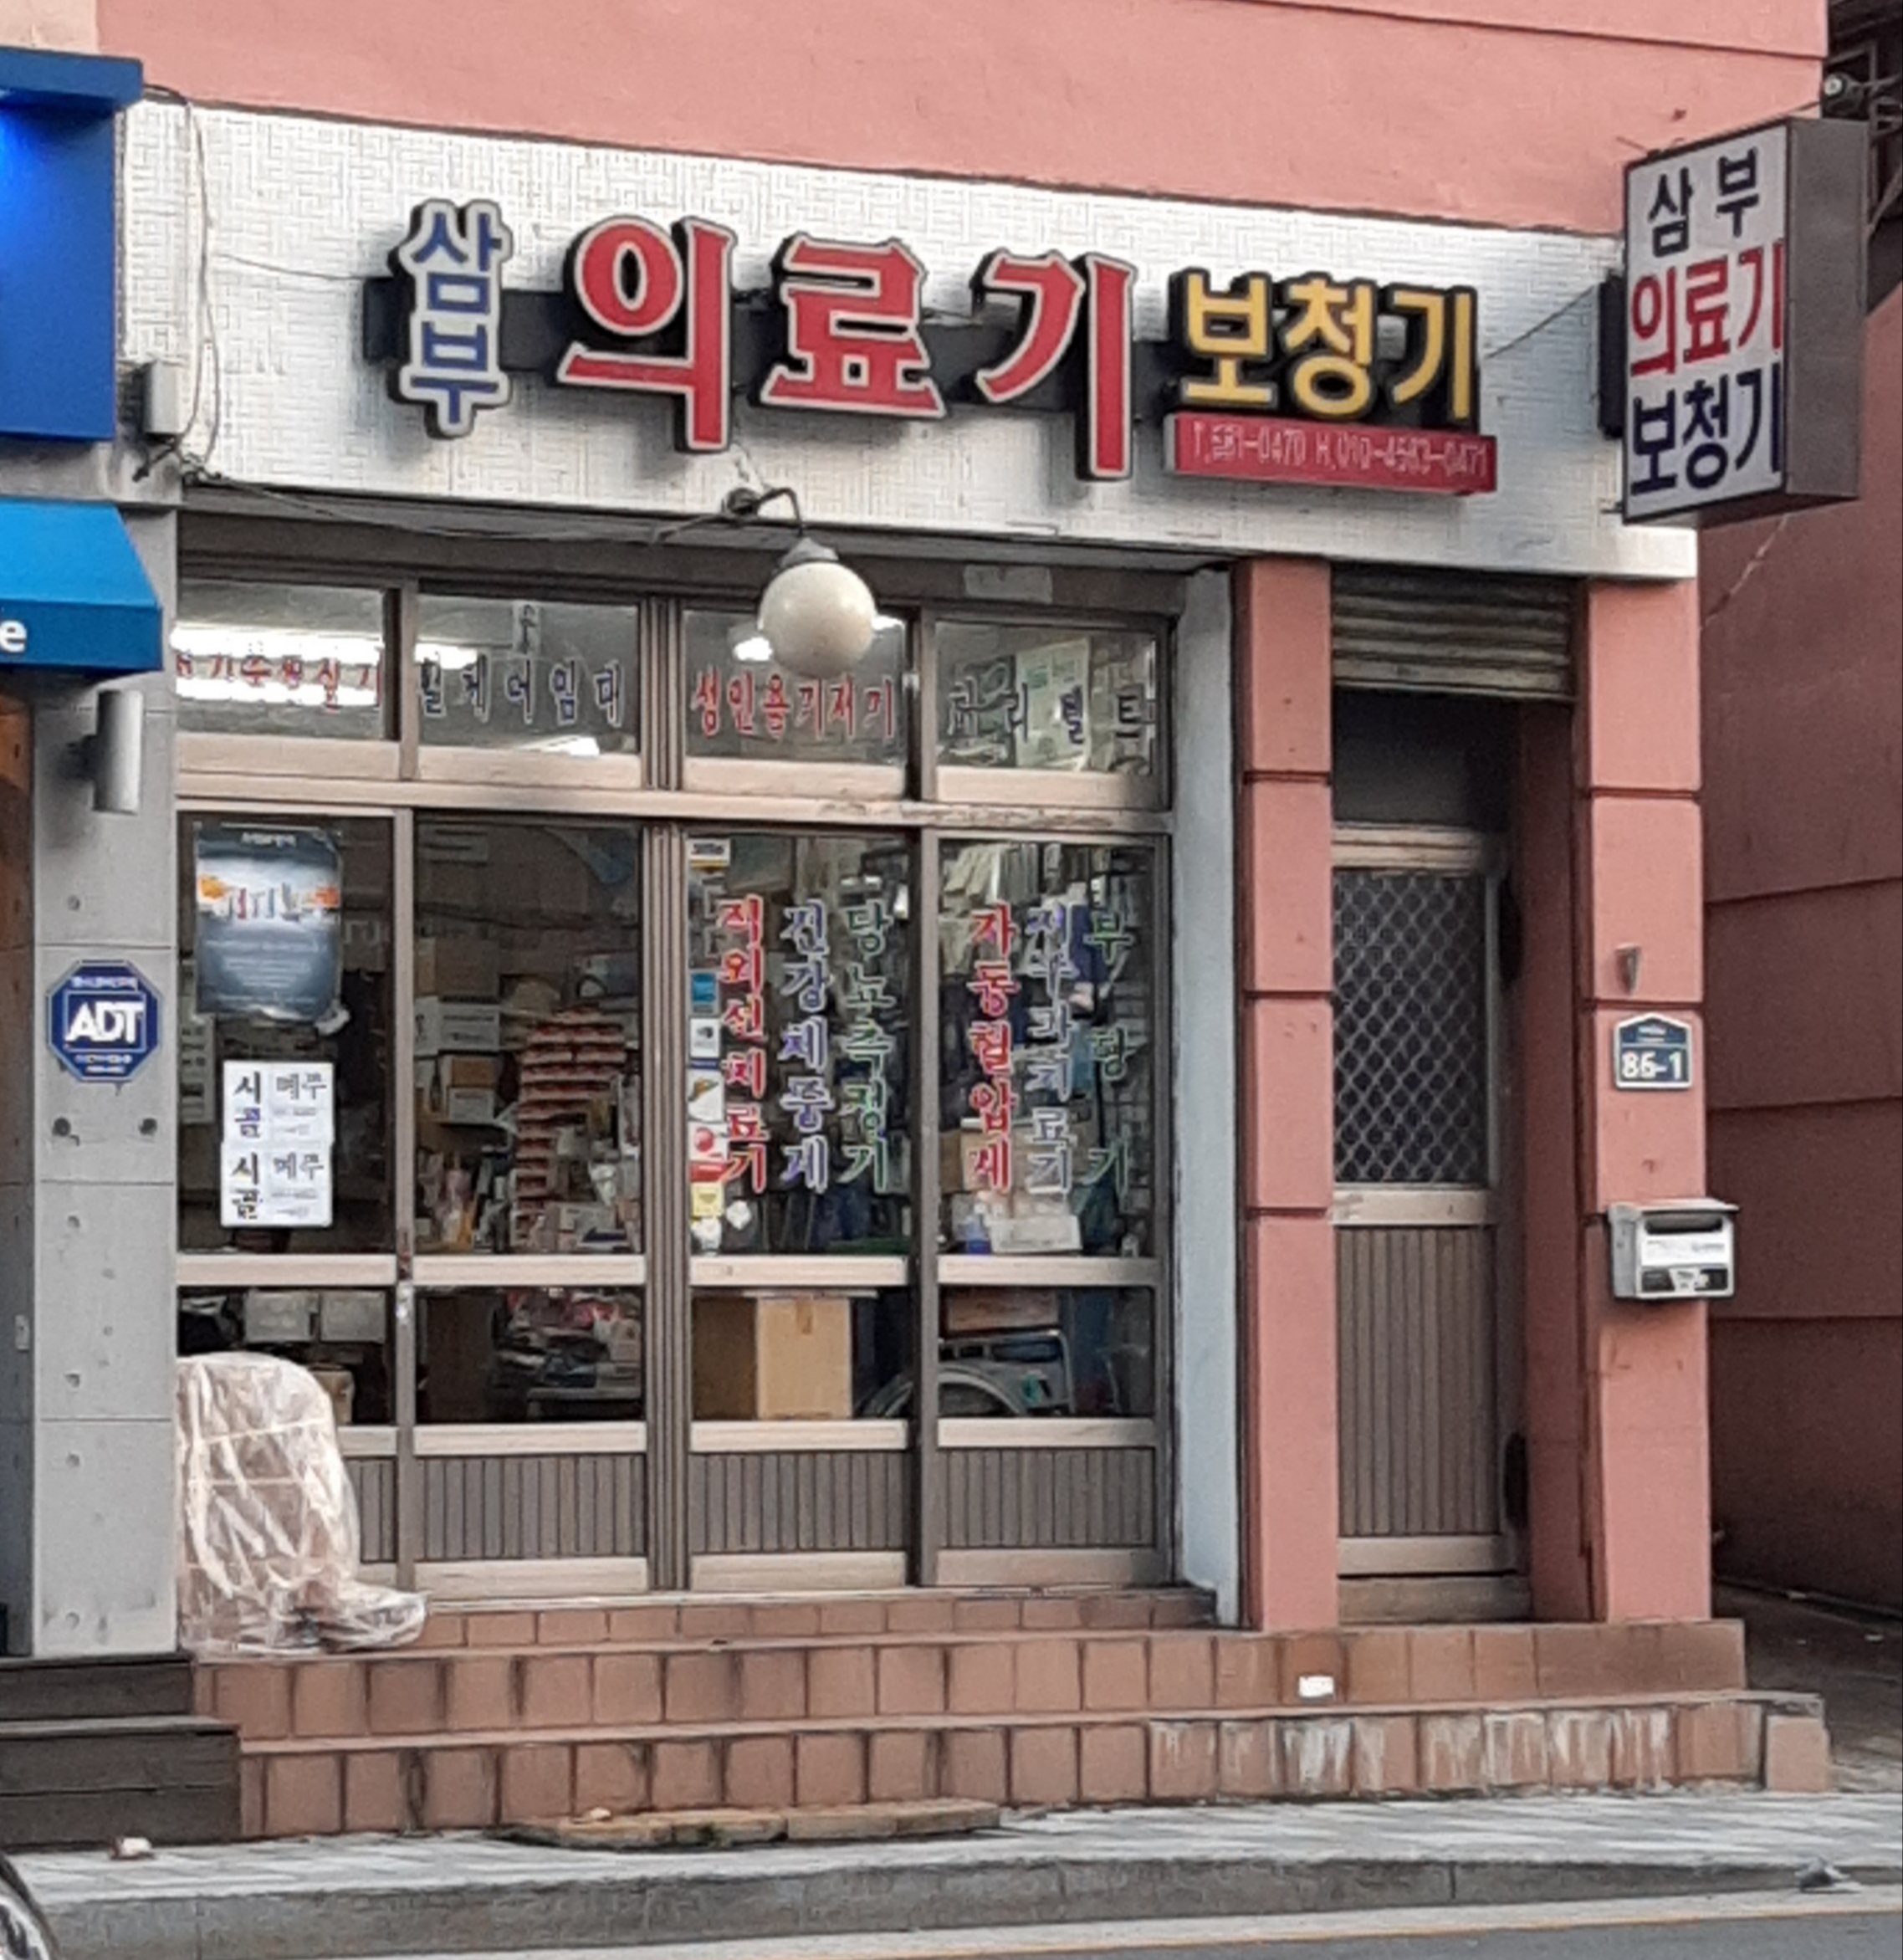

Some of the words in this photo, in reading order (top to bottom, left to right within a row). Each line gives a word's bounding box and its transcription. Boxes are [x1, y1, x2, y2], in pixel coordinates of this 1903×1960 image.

[408, 209, 504, 425] 삼부
[562, 219, 1131, 473] 의료기
[1184, 272, 1473, 419] 보청기
[1629, 238, 1784, 377] 의료기
[1629, 361, 1782, 497] 보청기
[64, 1001, 145, 1043] ADT
[1621, 1051, 1683, 1080] 86-1
